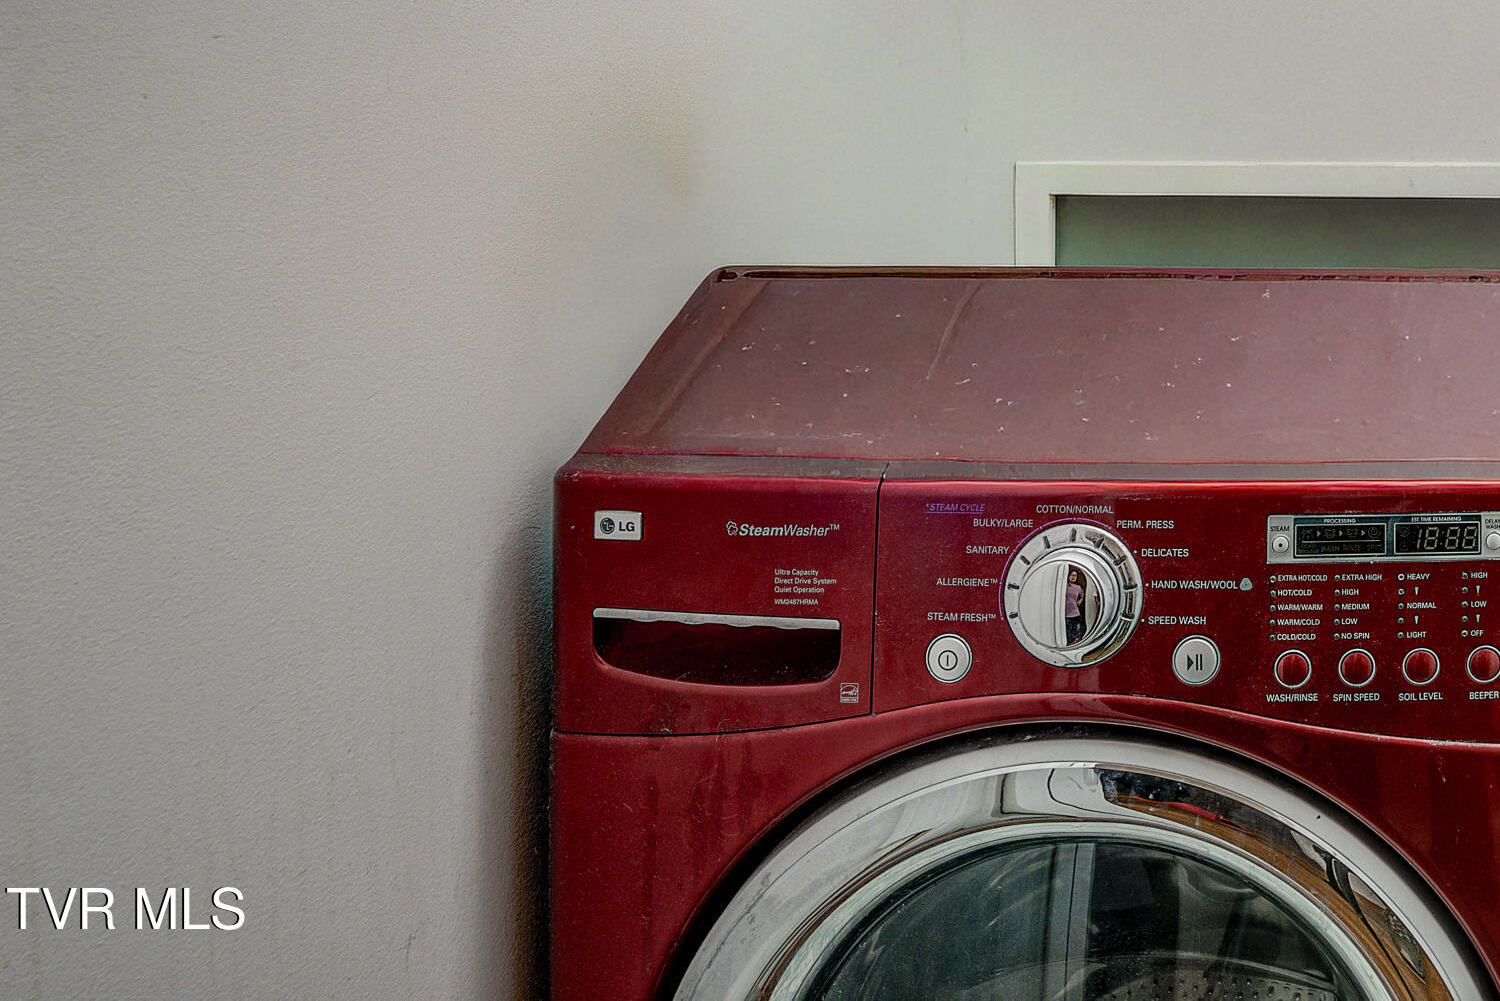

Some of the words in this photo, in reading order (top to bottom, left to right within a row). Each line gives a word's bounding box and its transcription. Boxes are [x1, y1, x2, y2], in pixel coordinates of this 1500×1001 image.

[960, 503, 985, 512] CYCLE
[1036, 504, 1113, 514] COTTON/NORMAL
[618, 521, 635, 532] LG
[973, 518, 1034, 528] BULKY/LARGE
[1116, 520, 1144, 529] PERM.
[1146, 520, 1175, 529] PRESS
[965, 545, 1010, 554] SANITARY
[1141, 548, 1190, 557] DELICATES
[774, 568, 791, 576] Ultra
[791, 568, 819, 577] Capacity
[1341, 573, 1364, 581] EXTRA
[1365, 573, 1382, 581] HIGH
[1470, 571, 1488, 579] HIGH
[812, 577, 837, 586] System
[1151, 580, 1178, 589] HAND
[1180, 580, 1238, 589] WASH/WOOL
[792, 586, 825, 594] Operation
[1277, 589, 1313, 597] HOT/COLD
[1341, 588, 1359, 596] HIGH
[1406, 602, 1437, 610] NORMAL
[1470, 600, 1487, 608] LOW
[927, 611, 958, 621] STEAM
[1148, 615, 1177, 625] SPEED
[1178, 615, 1207, 625] WASH
[1277, 618, 1321, 626] WARM/COLD
[1341, 617, 1358, 625] LOW
[1276, 633, 1316, 641] COLD/COLD
[1341, 632, 1353, 640] NO
[1353, 632, 1370, 640] SPIN
[1406, 631, 1427, 639] LIGHT
[1470, 629, 1484, 637] OFF
[1266, 693, 1319, 702] WASH/RINSE
[1333, 692, 1353, 702] SPIN
[1353, 692, 1380, 701] SPEED
[1398, 692, 1417, 701] SOIL
[1418, 691, 1443, 701] LEVEL
[1469, 690, 1500, 700] BEEPER
